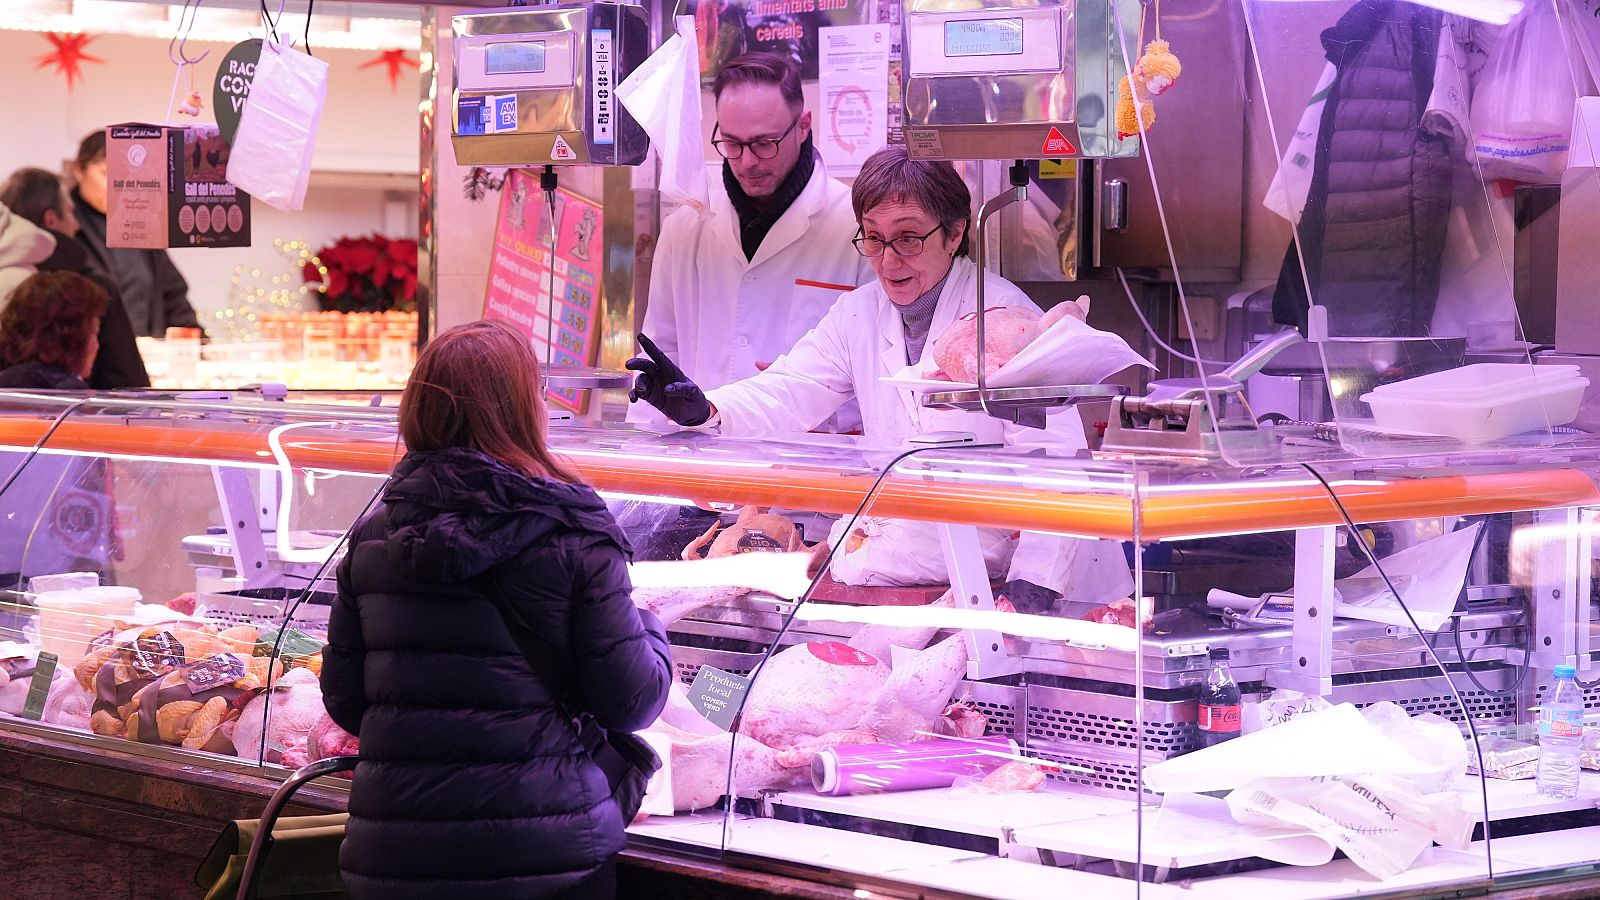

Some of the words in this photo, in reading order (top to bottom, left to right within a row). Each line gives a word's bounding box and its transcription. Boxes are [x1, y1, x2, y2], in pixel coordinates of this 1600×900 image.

[756, 21, 804, 42] cereals
[184, 182, 197, 196] Gall
[197, 182, 208, 196] del
[703, 670, 745, 691] Producte
[707, 683, 732, 698] local
